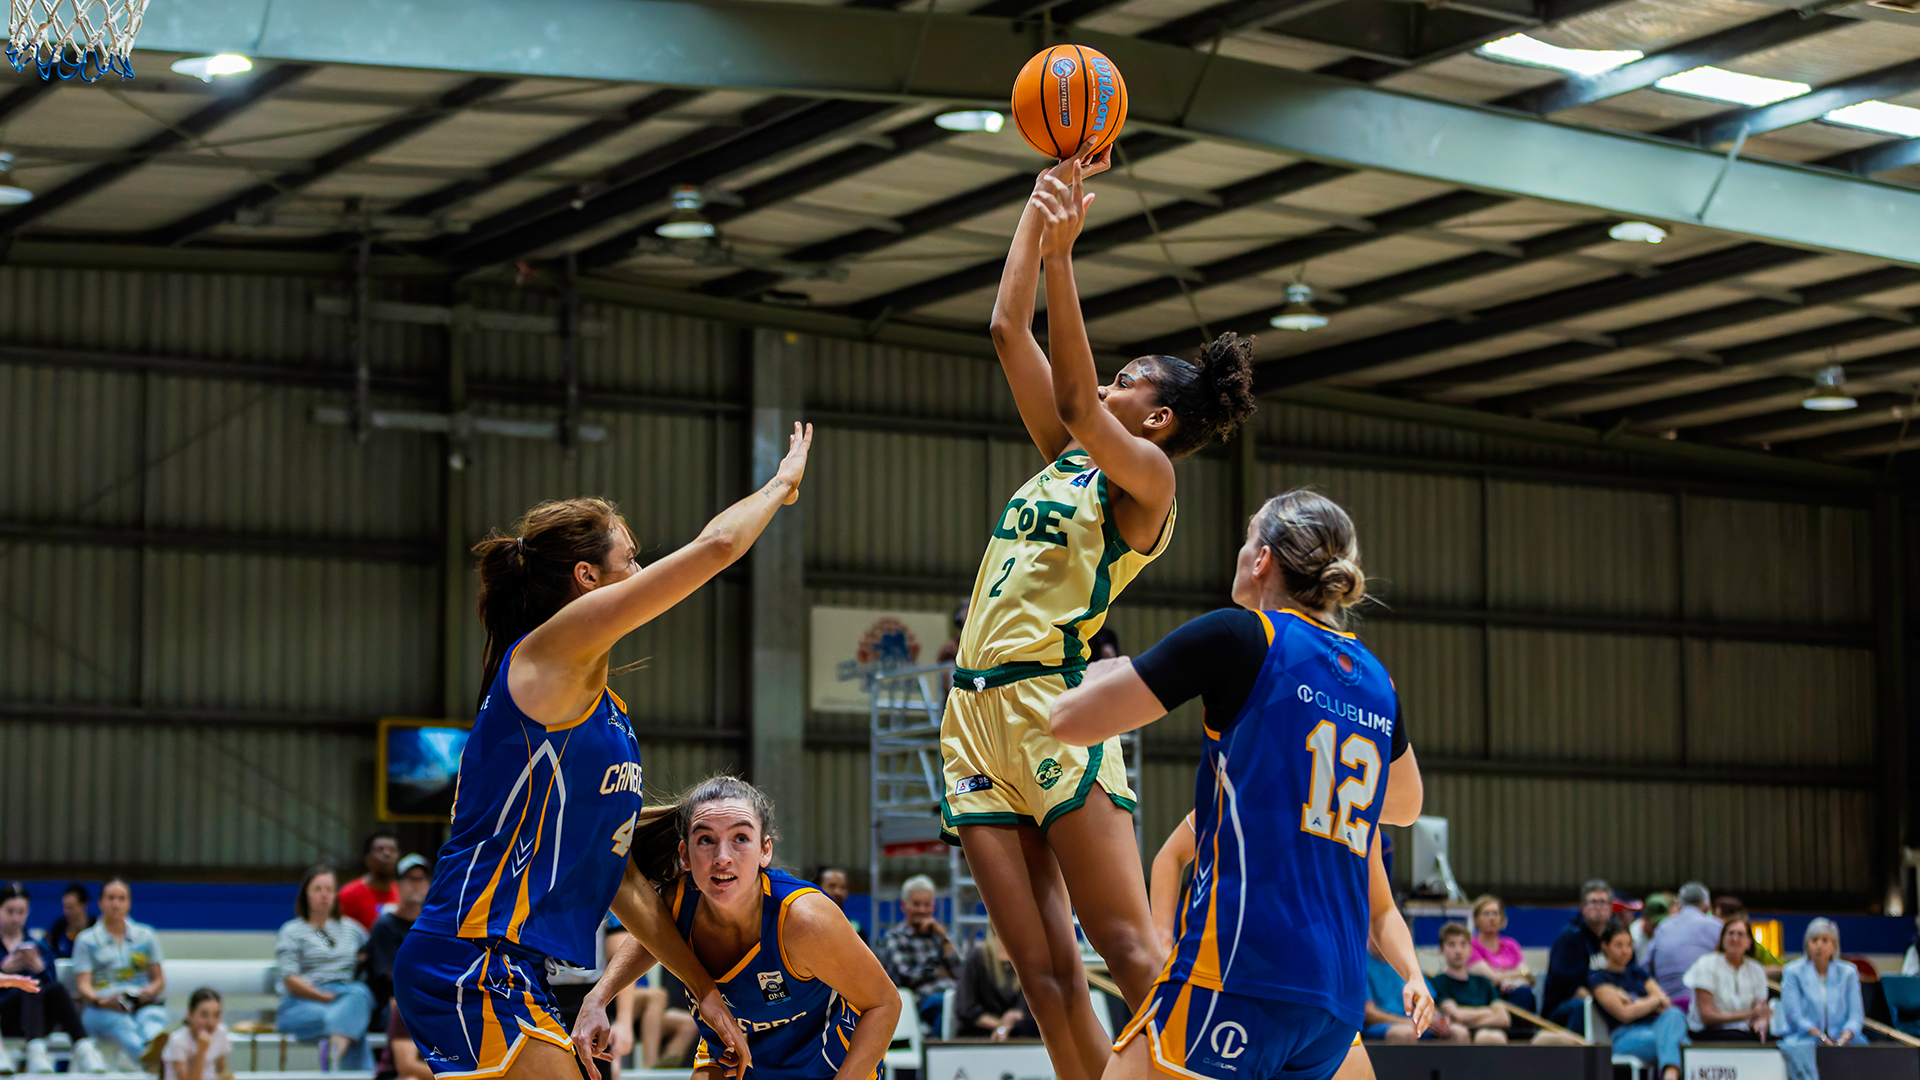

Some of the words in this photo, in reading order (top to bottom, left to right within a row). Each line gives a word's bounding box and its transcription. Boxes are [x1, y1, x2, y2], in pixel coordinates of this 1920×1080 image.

[1060, 78, 1068, 111] BASKETBALL
[1091, 57, 1114, 131] Wilson
[988, 557, 1016, 598] 2
[1300, 719, 1382, 858] 12
[611, 810, 637, 857] 4
